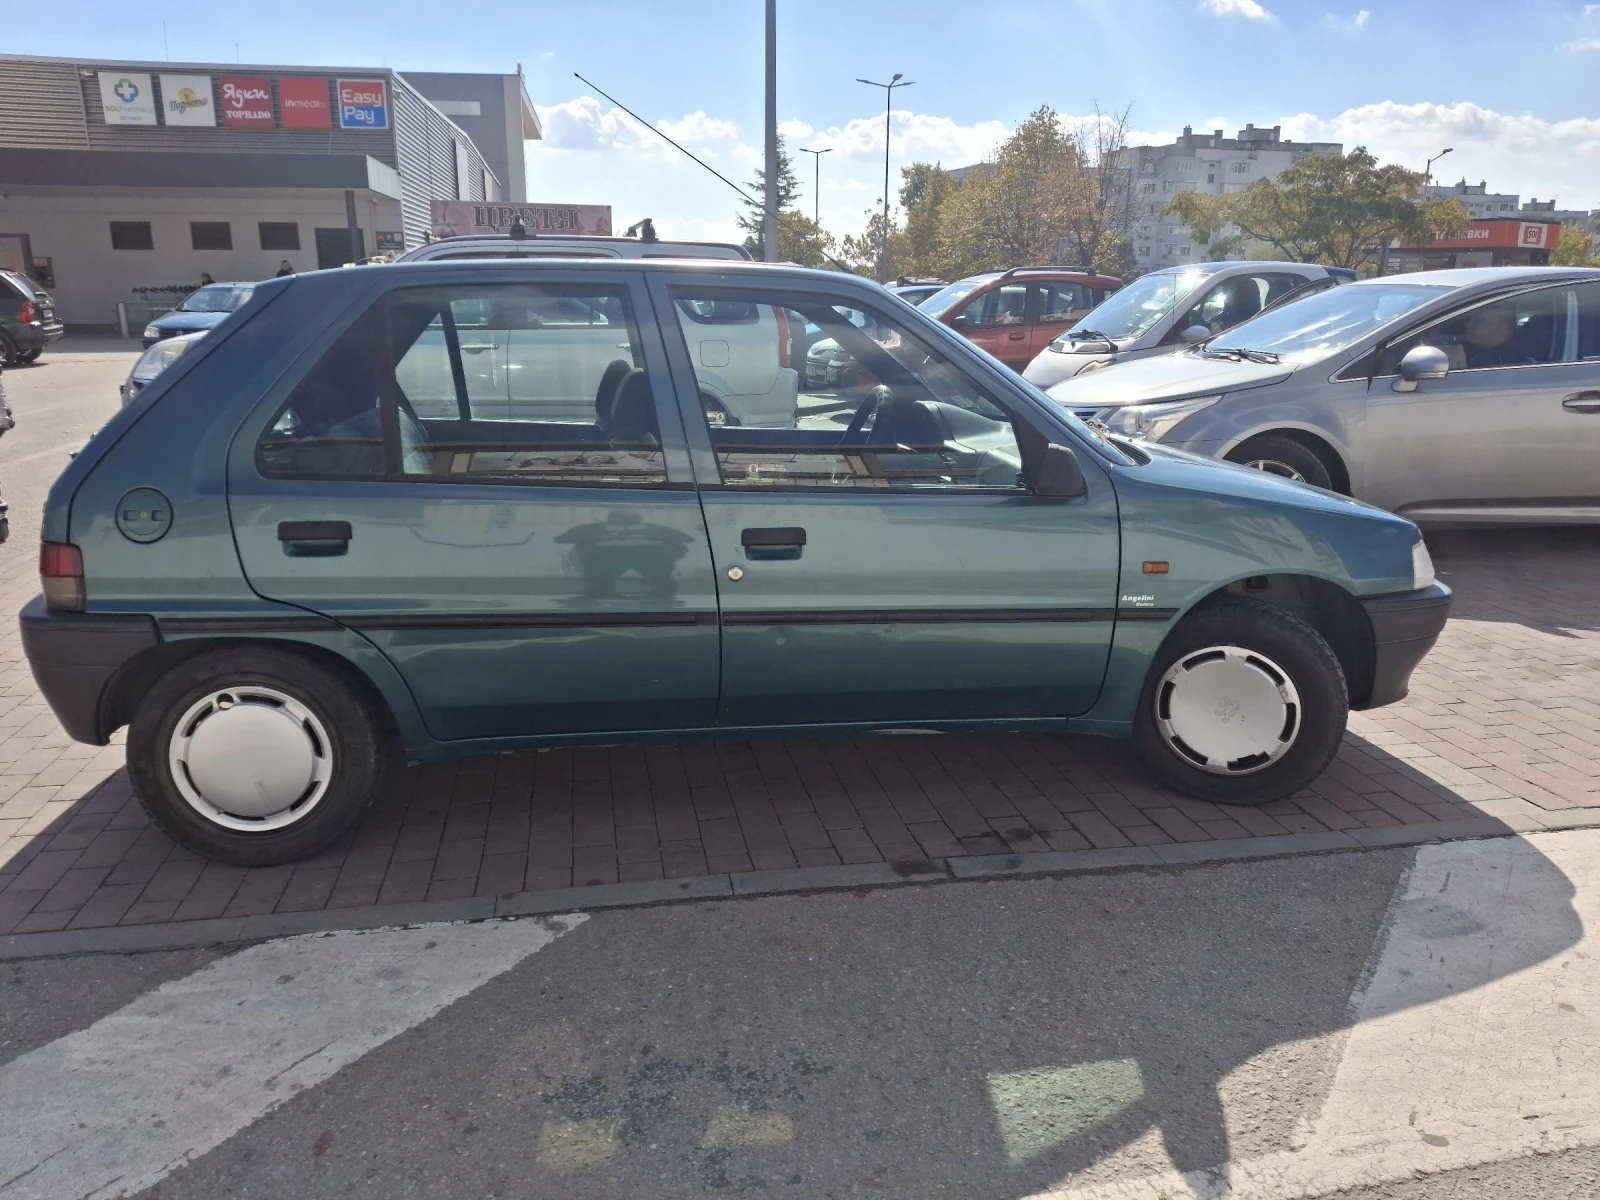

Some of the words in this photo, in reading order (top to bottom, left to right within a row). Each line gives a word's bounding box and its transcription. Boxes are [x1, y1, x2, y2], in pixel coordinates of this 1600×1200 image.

[341, 89, 383, 107] Easy
[343, 106, 375, 124] Pay
[473, 206, 578, 232] ЦВЕТЯ
[1121, 594, 1155, 603] Angelini
